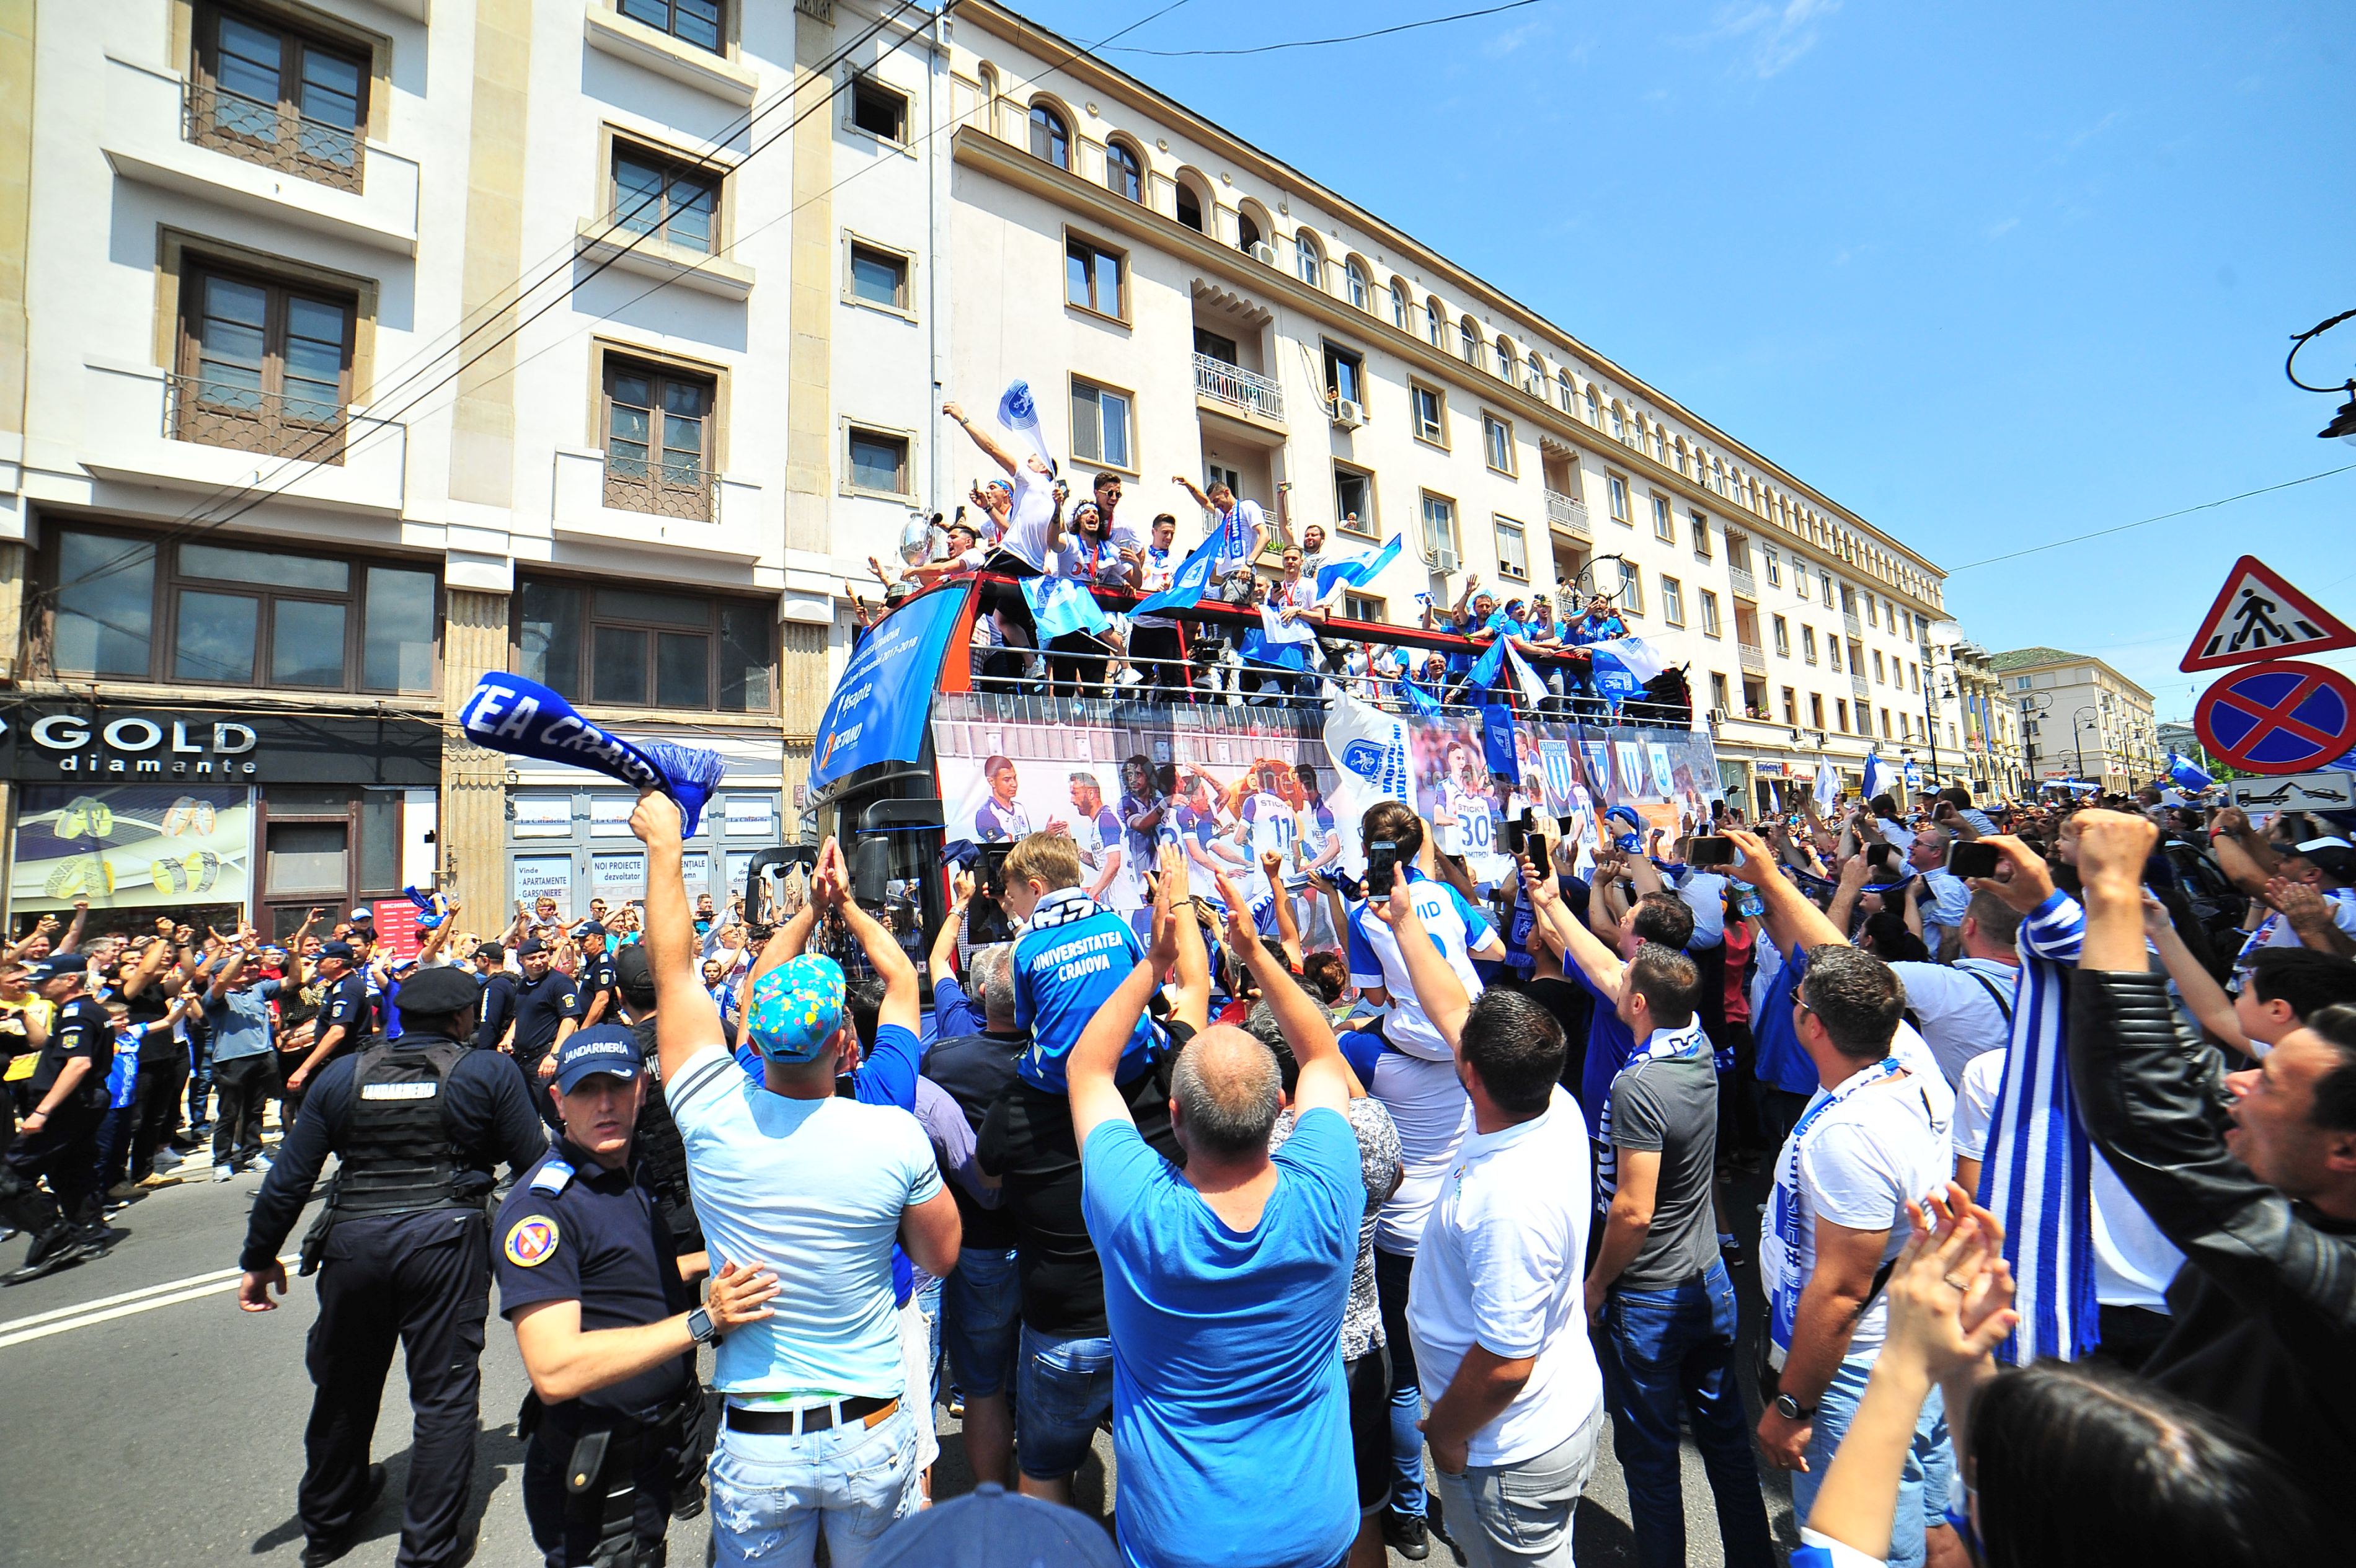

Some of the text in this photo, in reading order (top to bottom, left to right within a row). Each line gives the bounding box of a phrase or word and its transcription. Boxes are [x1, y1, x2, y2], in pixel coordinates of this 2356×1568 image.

[881, 636, 919, 665] 2017-2018
[30, 715, 257, 754] GOLD
[831, 722, 863, 753] BETANO
[60, 754, 257, 774] diamante
[541, 715, 661, 786] CRAIO
[1458, 804, 1485, 813] STICKY
[1269, 815, 1291, 849] 11
[1458, 814, 1489, 846] 30
[595, 861, 641, 870] NOI PROIECTE
[522, 876, 567, 886] APARTAMENTE
[522, 888, 562, 898] GARSONIERE
[524, 901, 534, 910] CAS
[1416, 900, 1441, 919] VID
[1032, 930, 1123, 972] UNIVERSITATEA
[1058, 953, 1110, 982] CRAIOVA
